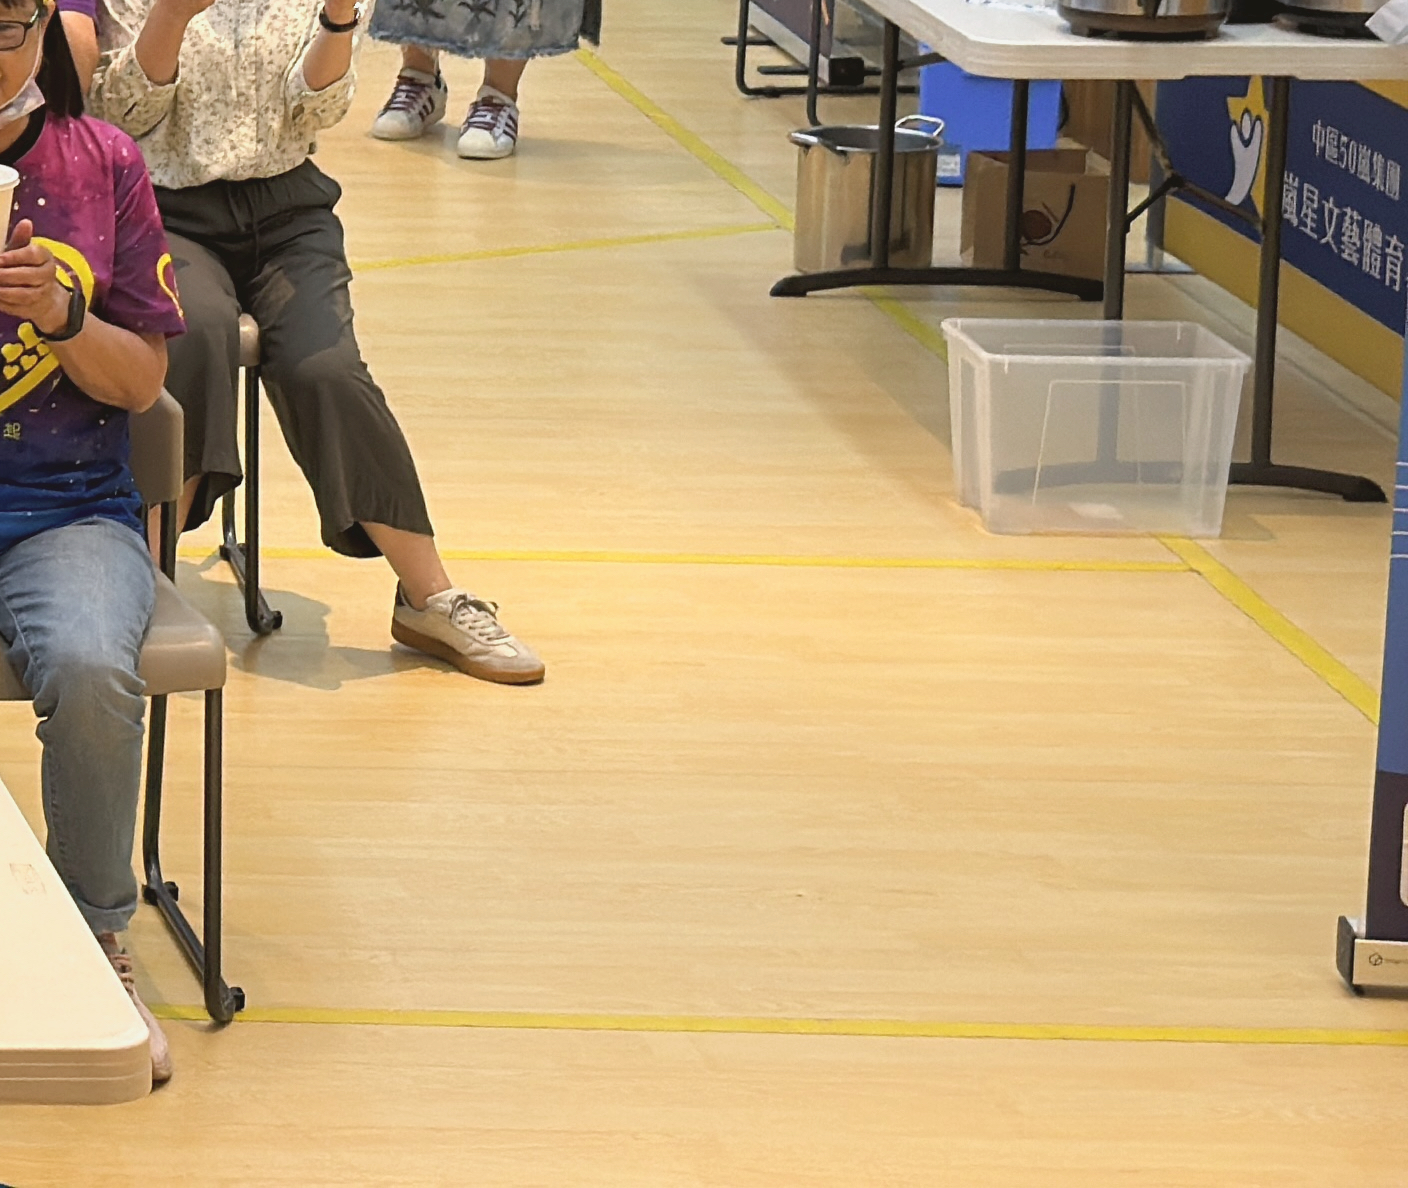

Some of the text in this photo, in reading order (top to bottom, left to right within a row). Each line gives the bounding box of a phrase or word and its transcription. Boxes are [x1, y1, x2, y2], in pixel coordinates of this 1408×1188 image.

[1283, 170, 1408, 292] 嵐星文藝體育
